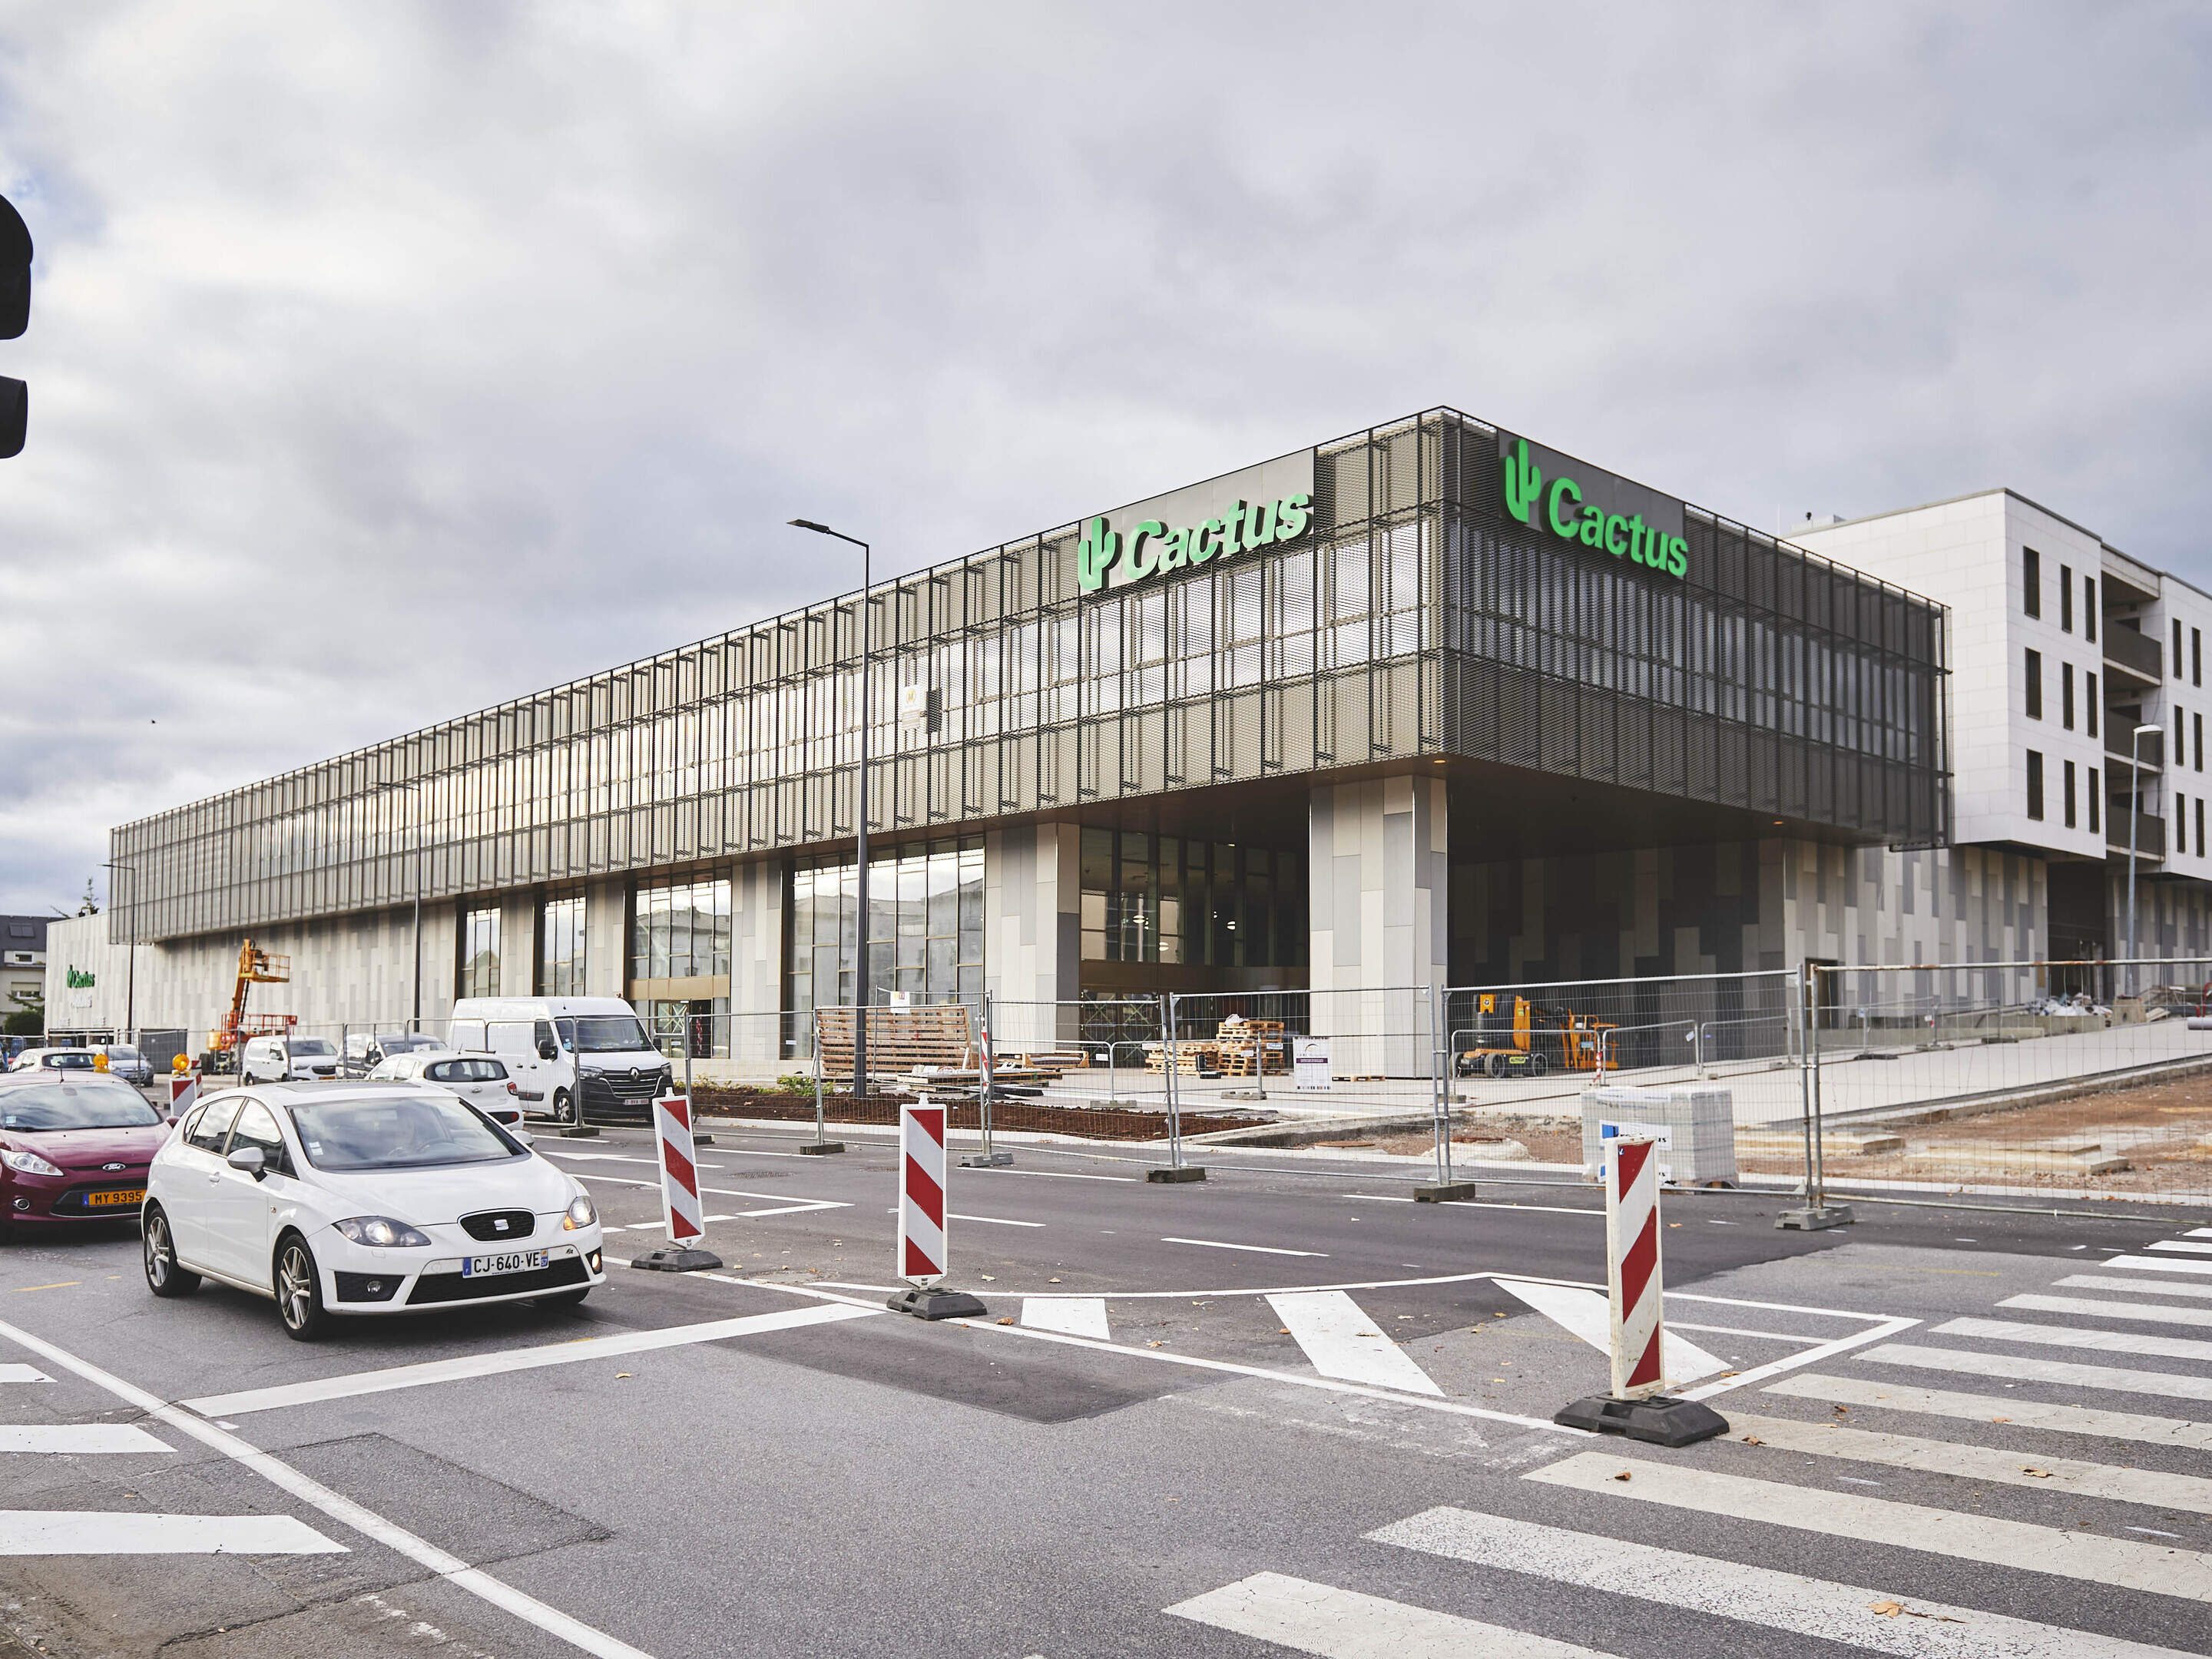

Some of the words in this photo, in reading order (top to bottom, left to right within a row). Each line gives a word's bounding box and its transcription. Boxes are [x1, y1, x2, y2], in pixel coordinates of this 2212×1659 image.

[1124, 493, 1311, 579] Cactus
[1548, 477, 1688, 577] Cactus
[73, 970, 95, 988] Cactus
[94, 1194, 109, 1204] MY
[113, 1191, 142, 1203] 9395
[474, 1252, 540, 1273] CJ-640-VE
